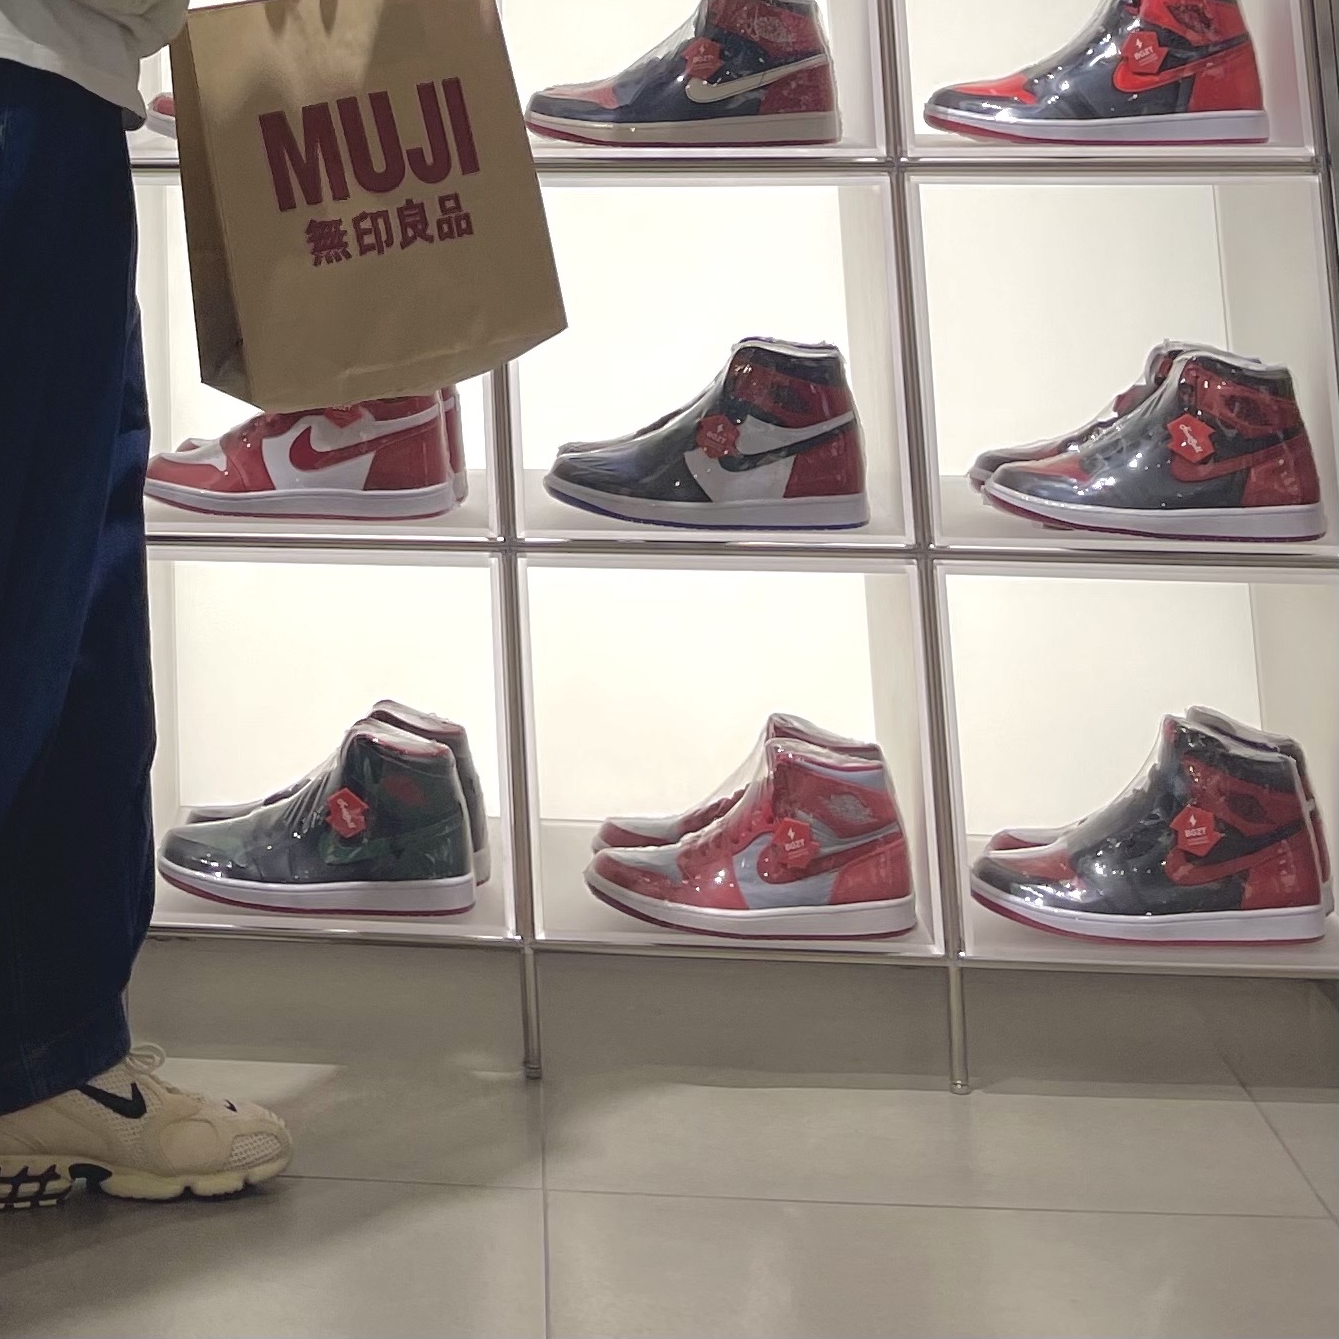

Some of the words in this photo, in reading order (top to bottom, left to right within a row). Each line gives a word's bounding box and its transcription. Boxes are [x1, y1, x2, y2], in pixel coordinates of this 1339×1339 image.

[258, 76, 481, 212] MUJI
[304, 192, 474, 267] 無印良品
